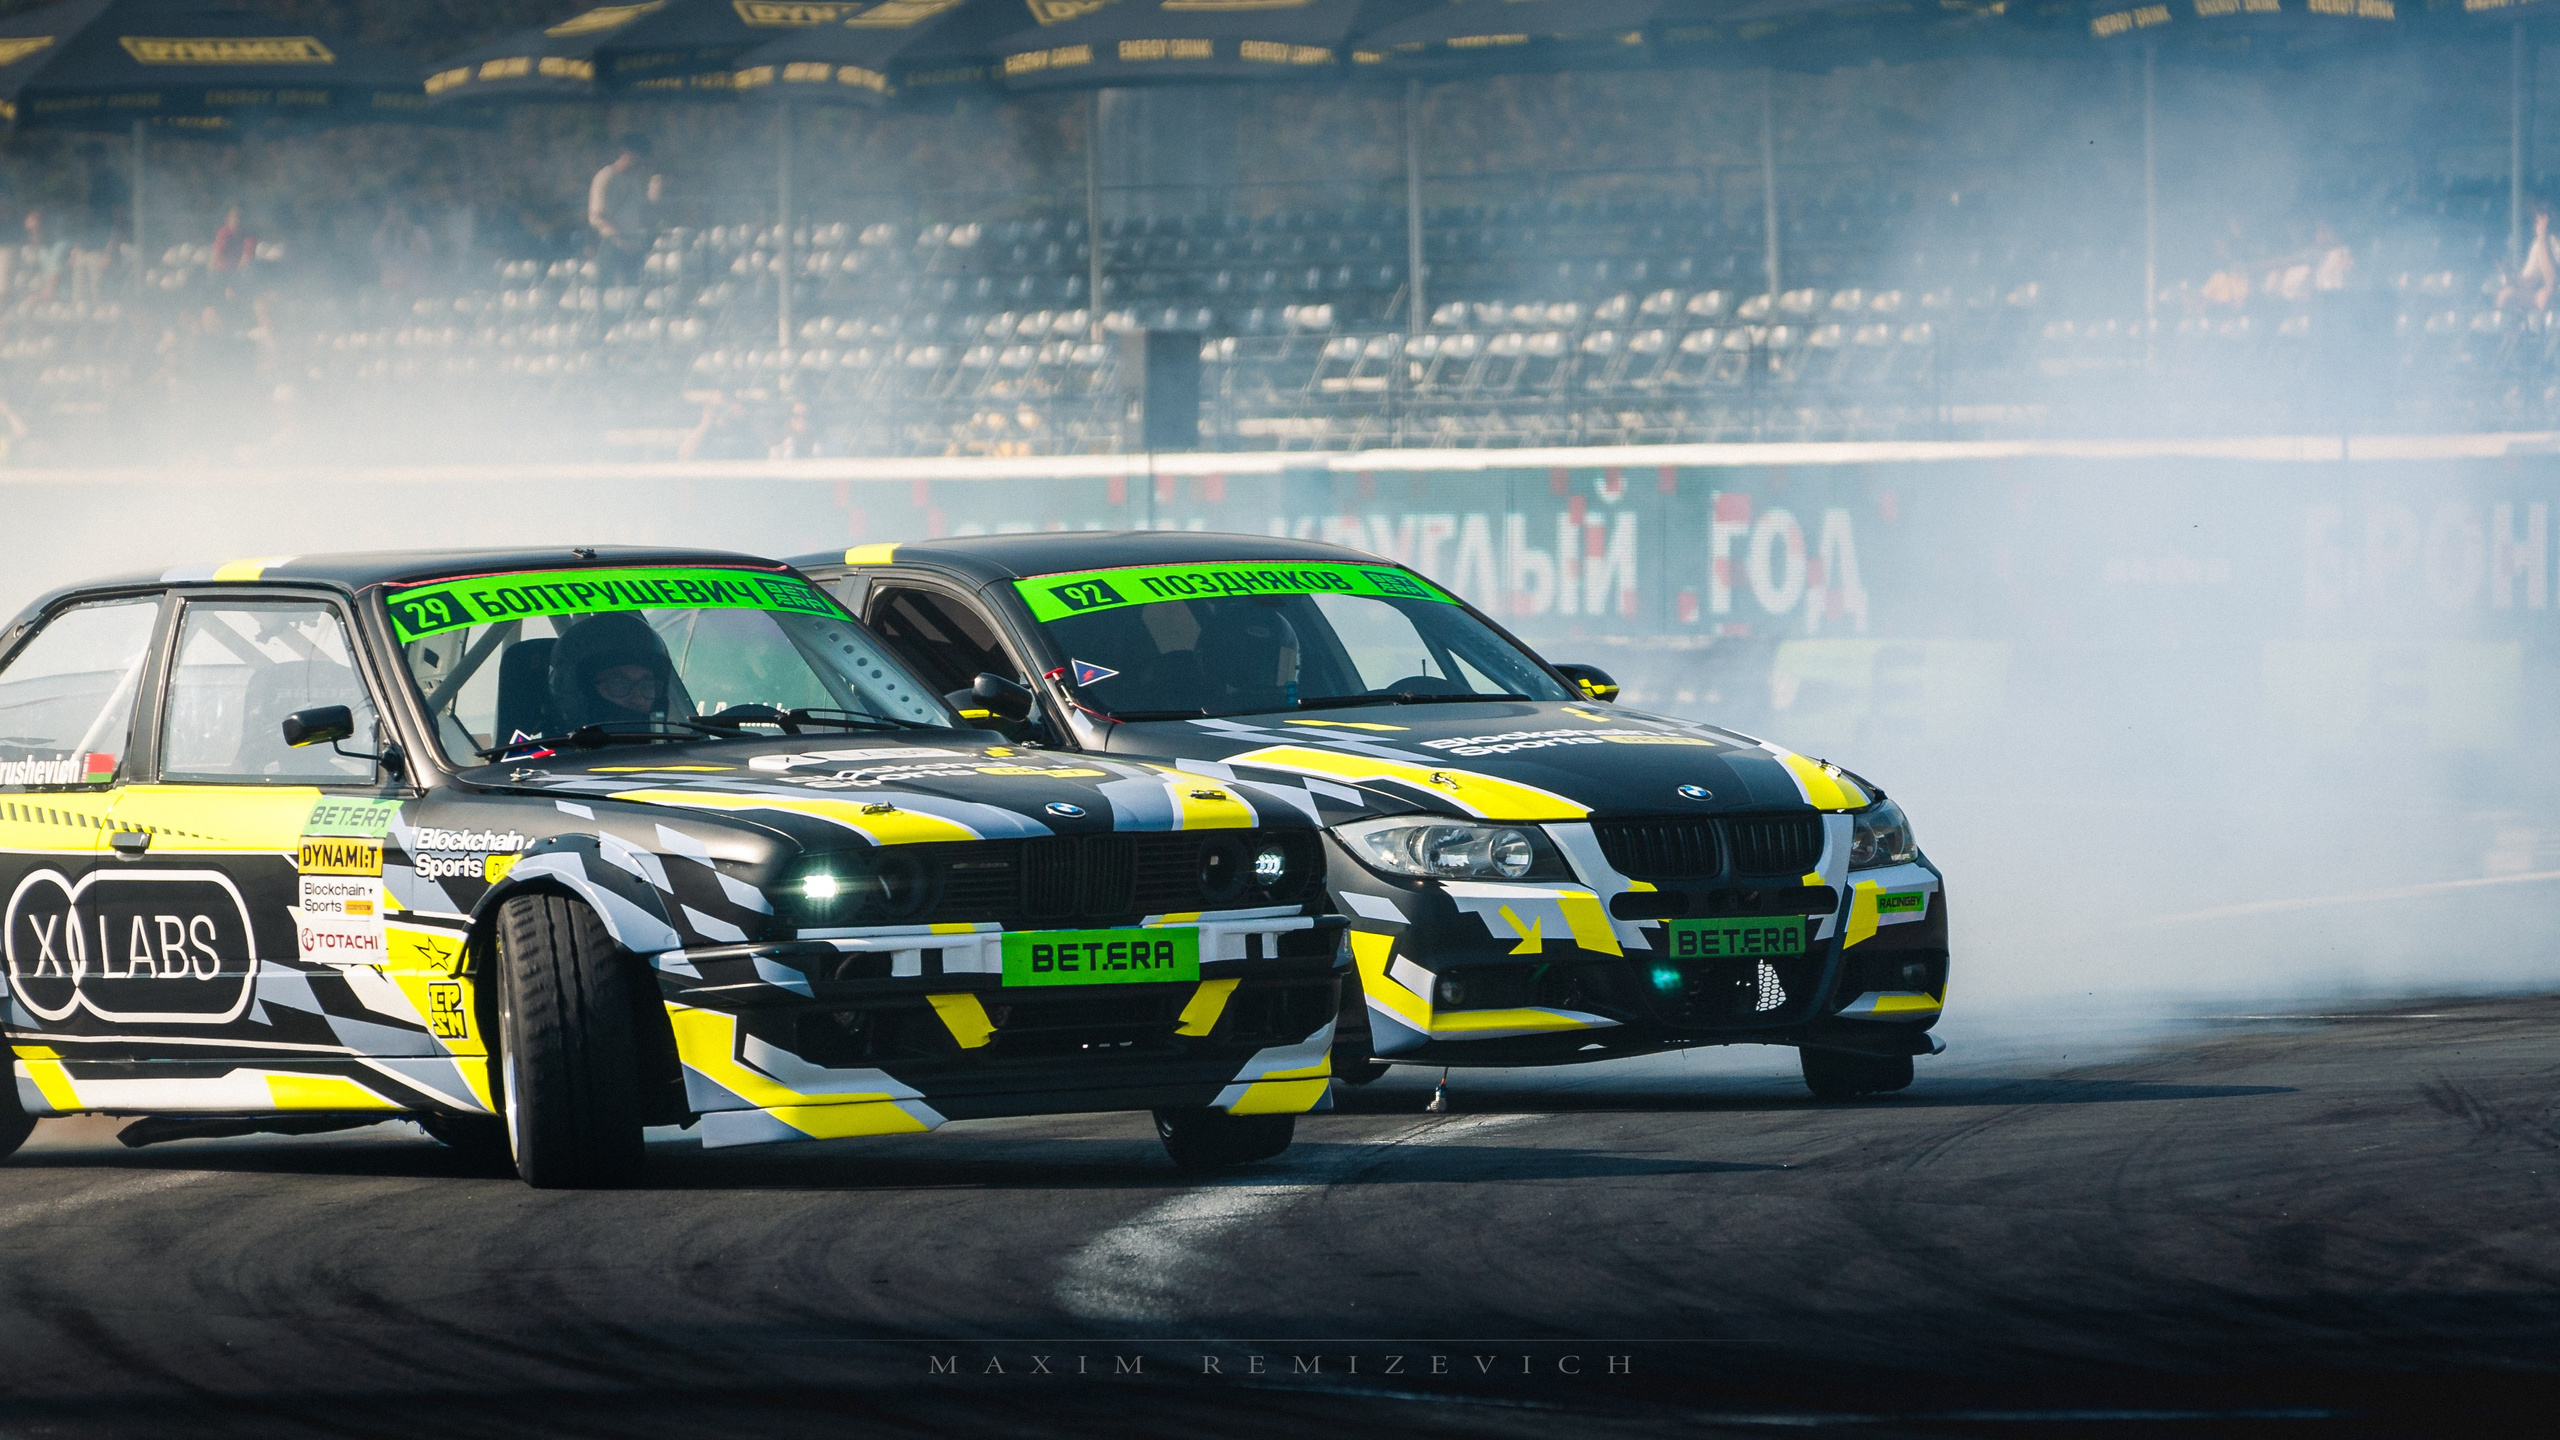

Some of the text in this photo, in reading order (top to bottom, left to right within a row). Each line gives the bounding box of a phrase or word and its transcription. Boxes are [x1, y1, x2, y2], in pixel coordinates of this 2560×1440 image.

[1708, 503, 1868, 635] ГОД
[762, 582, 812, 598] BET
[1064, 570, 1353, 606] 92 ПОЗДНЯКОВ
[404, 579, 763, 629] 29 БОЛТРУШЕВИЧ
[1450, 736, 1604, 756] Sports
[416, 827, 525, 851] Blockchain
[415, 853, 482, 881] Sports
[305, 882, 366, 897] Blockchain
[305, 899, 342, 914] Sports
[99, 915, 220, 981] LABS
[316, 933, 379, 950] TOTACHI
